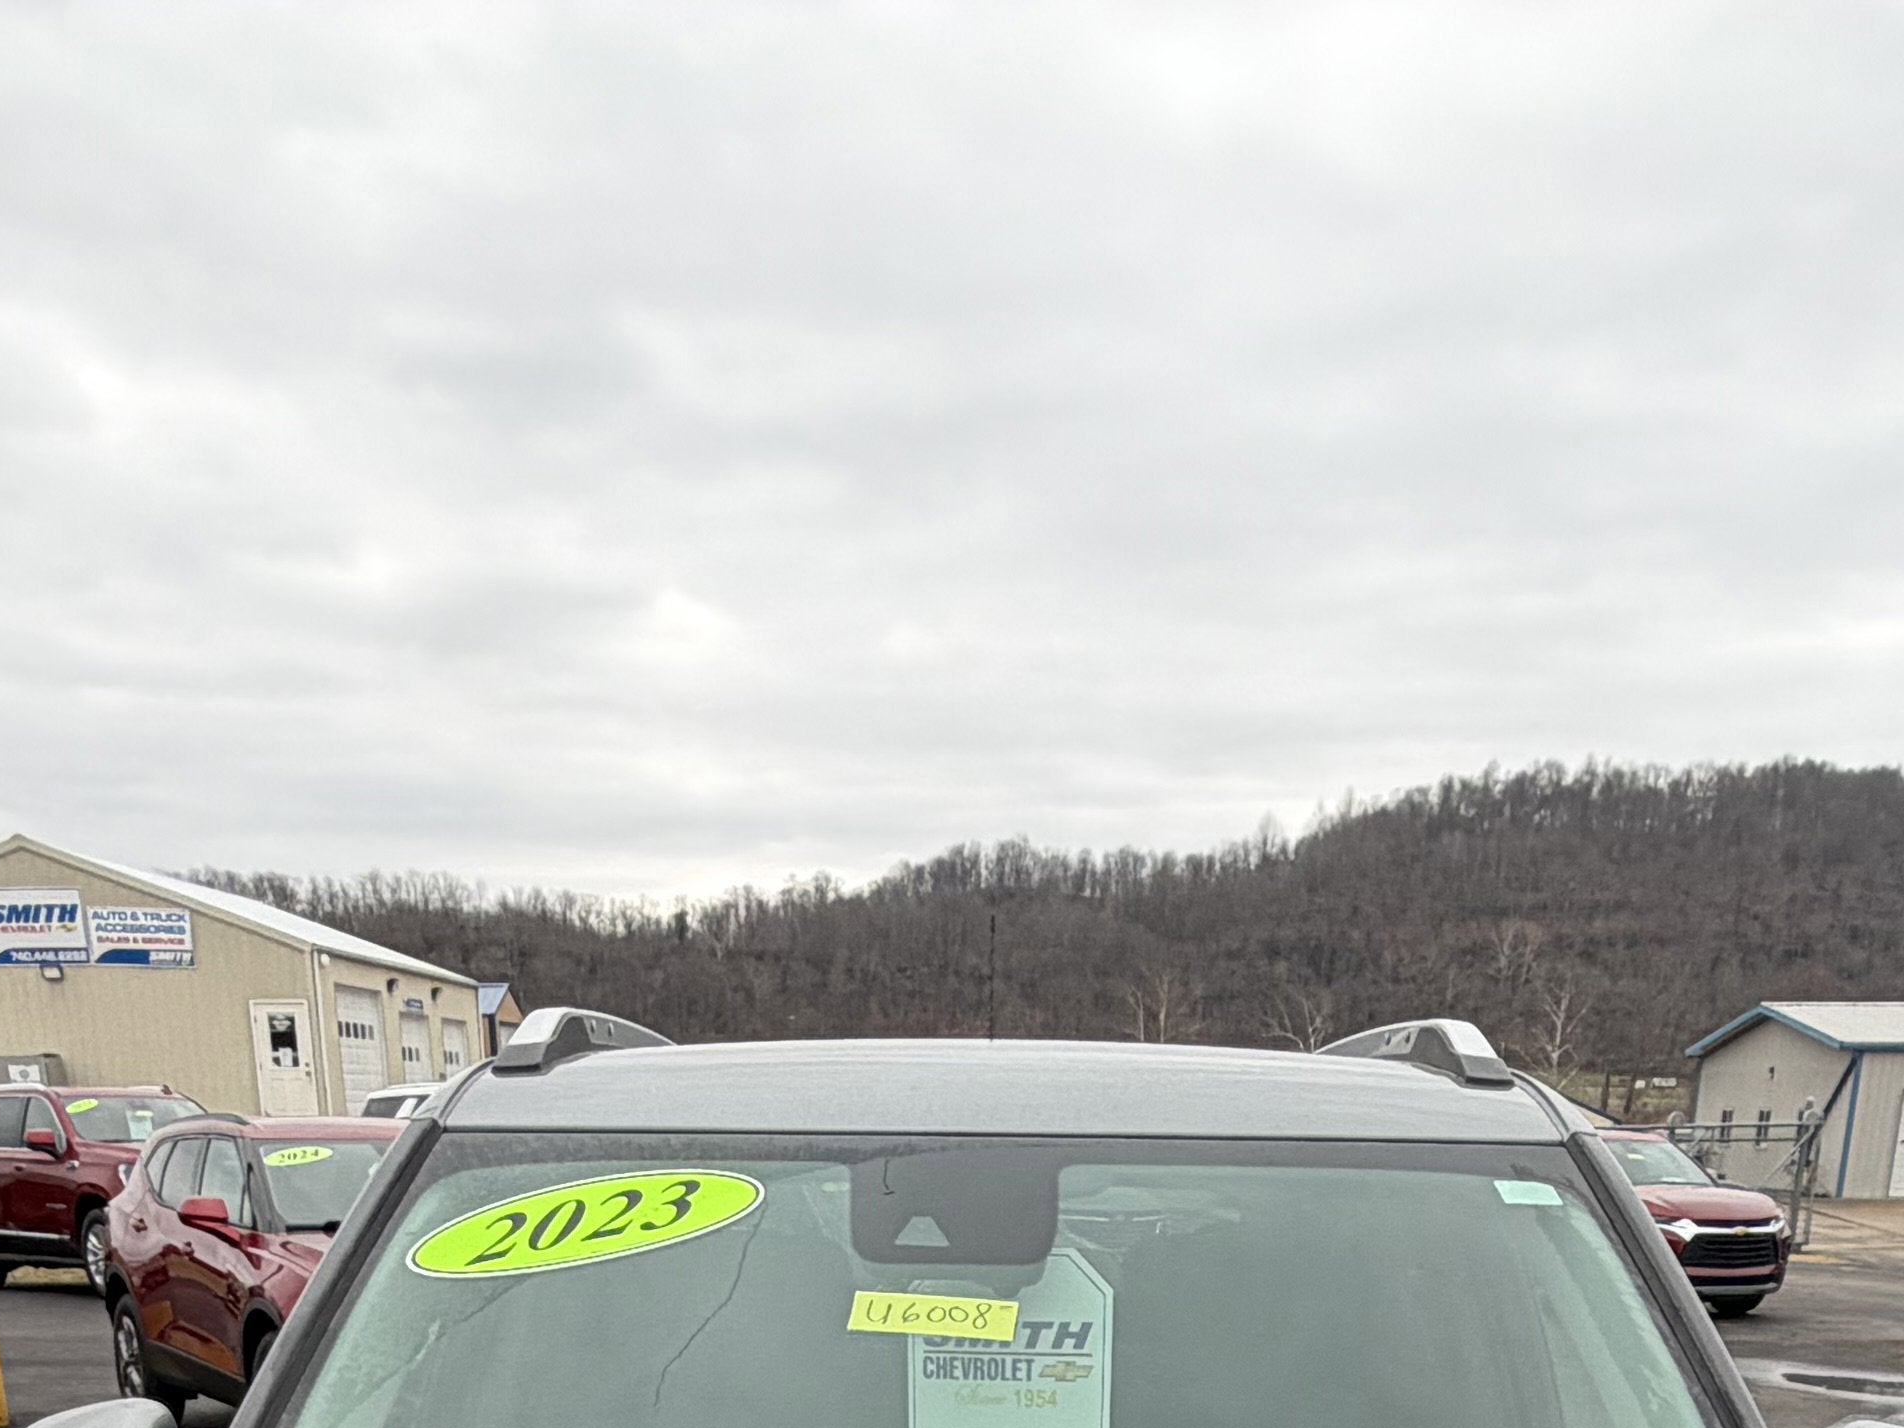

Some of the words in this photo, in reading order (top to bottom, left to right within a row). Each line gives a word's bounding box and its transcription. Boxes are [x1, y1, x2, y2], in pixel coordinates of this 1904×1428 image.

[92, 911, 128, 921] AUTO
[130, 911, 140, 921] &
[142, 912, 187, 923] TRUCK
[95, 923, 186, 935] ACCESSORIES
[464, 1179, 701, 1267] 2023
[922, 1355, 1036, 1383] CHEVROLET
[1014, 1388, 1059, 1409] 1954
